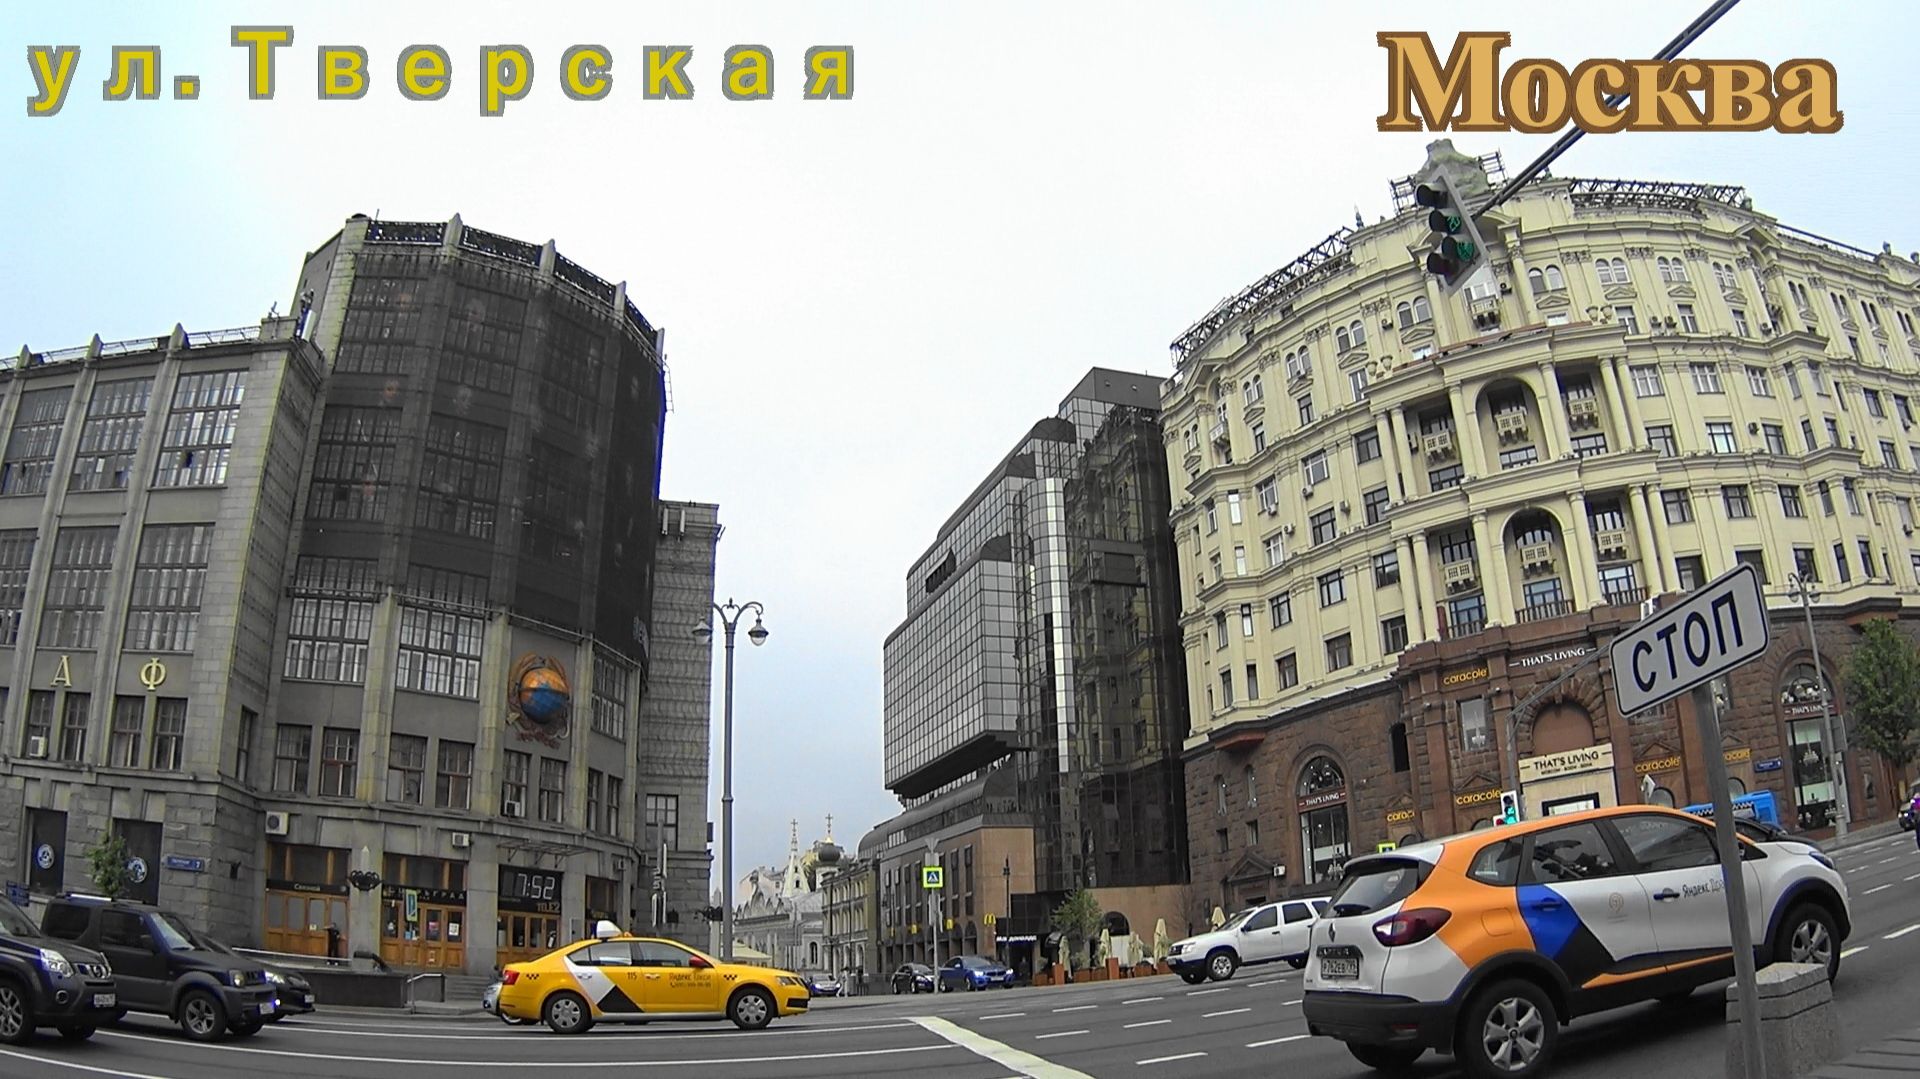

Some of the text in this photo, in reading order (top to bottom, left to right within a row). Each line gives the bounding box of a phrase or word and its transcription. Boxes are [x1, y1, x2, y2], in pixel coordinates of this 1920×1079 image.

[1632, 590, 1744, 693] СТОП
[1521, 647, 1586, 668] THAT'S LIVING
[1443, 667, 1488, 685] caracole
[1533, 756, 1567, 771] THAT'S
[1566, 750, 1599, 764] LIVING
[1634, 756, 1680, 773] caracole
[1456, 789, 1502, 805] caracole
[517, 873, 556, 900] 7:52
